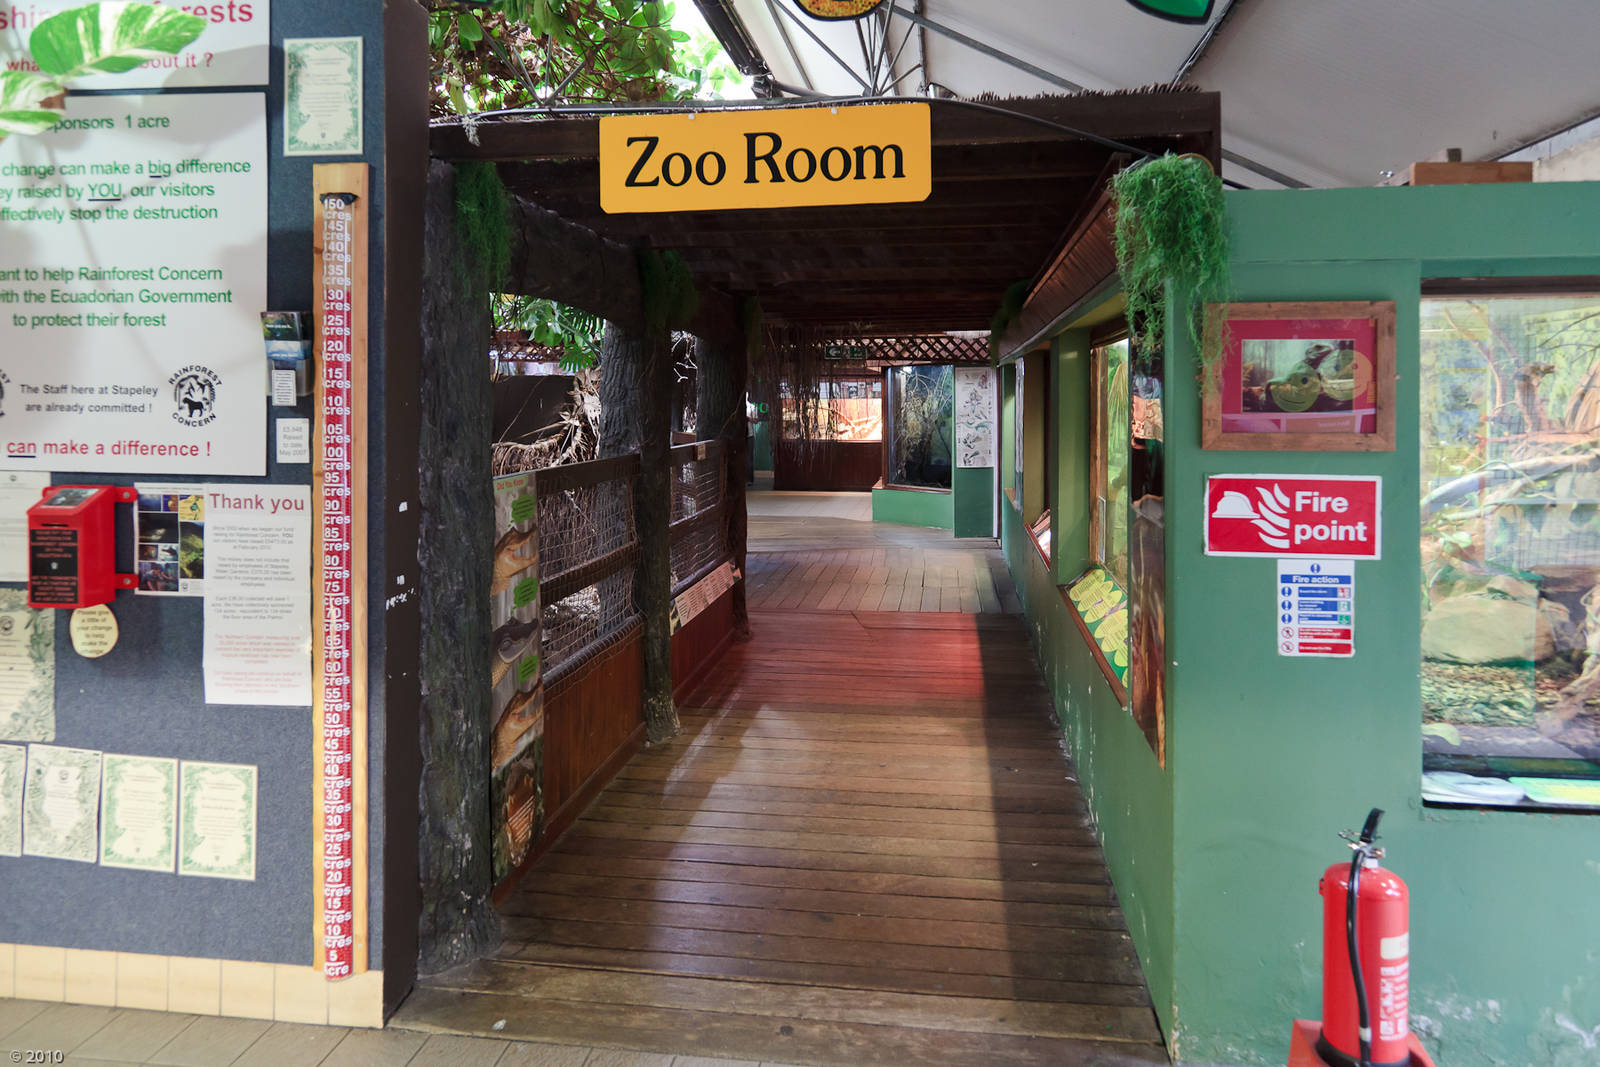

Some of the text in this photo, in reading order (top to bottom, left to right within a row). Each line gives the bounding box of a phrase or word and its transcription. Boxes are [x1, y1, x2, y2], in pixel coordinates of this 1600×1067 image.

[7, 57, 40, 72] wha
[185, 52, 196, 67] it
[203, 51, 213, 68] ?
[46, 113, 170, 133] ponsors 1 acre
[625, 132, 907, 188] Zoo Room
[2, 159, 251, 179] change can make a big difference
[18, 184, 61, 198] raised
[66, 183, 84, 201] by
[130, 185, 156, 198] our
[160, 182, 215, 197] visitors
[0, 204, 218, 224] ffectively stop the destruction
[25, 267, 39, 281] to
[43, 267, 74, 284] help
[78, 266, 154, 281] Rainforest
[159, 266, 223, 281] Concern
[0, 289, 233, 304] ith the Ecuadorian Government
[13, 312, 167, 329] to protect their forest
[168, 365, 223, 387] RAINFOREST
[20, 384, 159, 398] The Staff here at Stapeley
[25, 403, 42, 413] are
[45, 402, 84, 415] already
[88, 402, 145, 413] committed
[172, 412, 217, 428] CONCERN
[7, 440, 212, 457] can make a difference !
[324, 472, 340, 483] 95
[209, 493, 305, 515] Thank you
[324, 500, 340, 511] 90
[1295, 491, 1349, 513] Fire
[324, 527, 340, 538] 85
[1295, 520, 1368, 544] point
[324, 555, 339, 566] 80
[1292, 575, 1310, 583] Fire
[324, 581, 340, 592] 75
[326, 635, 341, 646] 65
[326, 661, 341, 672] 60
[325, 688, 341, 699] 55
[325, 713, 340, 724] 50
[324, 738, 339, 749] 45
[324, 764, 339, 775] 40
[326, 789, 341, 800] 35
[326, 815, 342, 826] 30
[325, 843, 341, 855] 25
[326, 871, 342, 883] 20
[326, 898, 341, 909] 15
[326, 924, 341, 936] 10
[329, 950, 338, 961] 5
